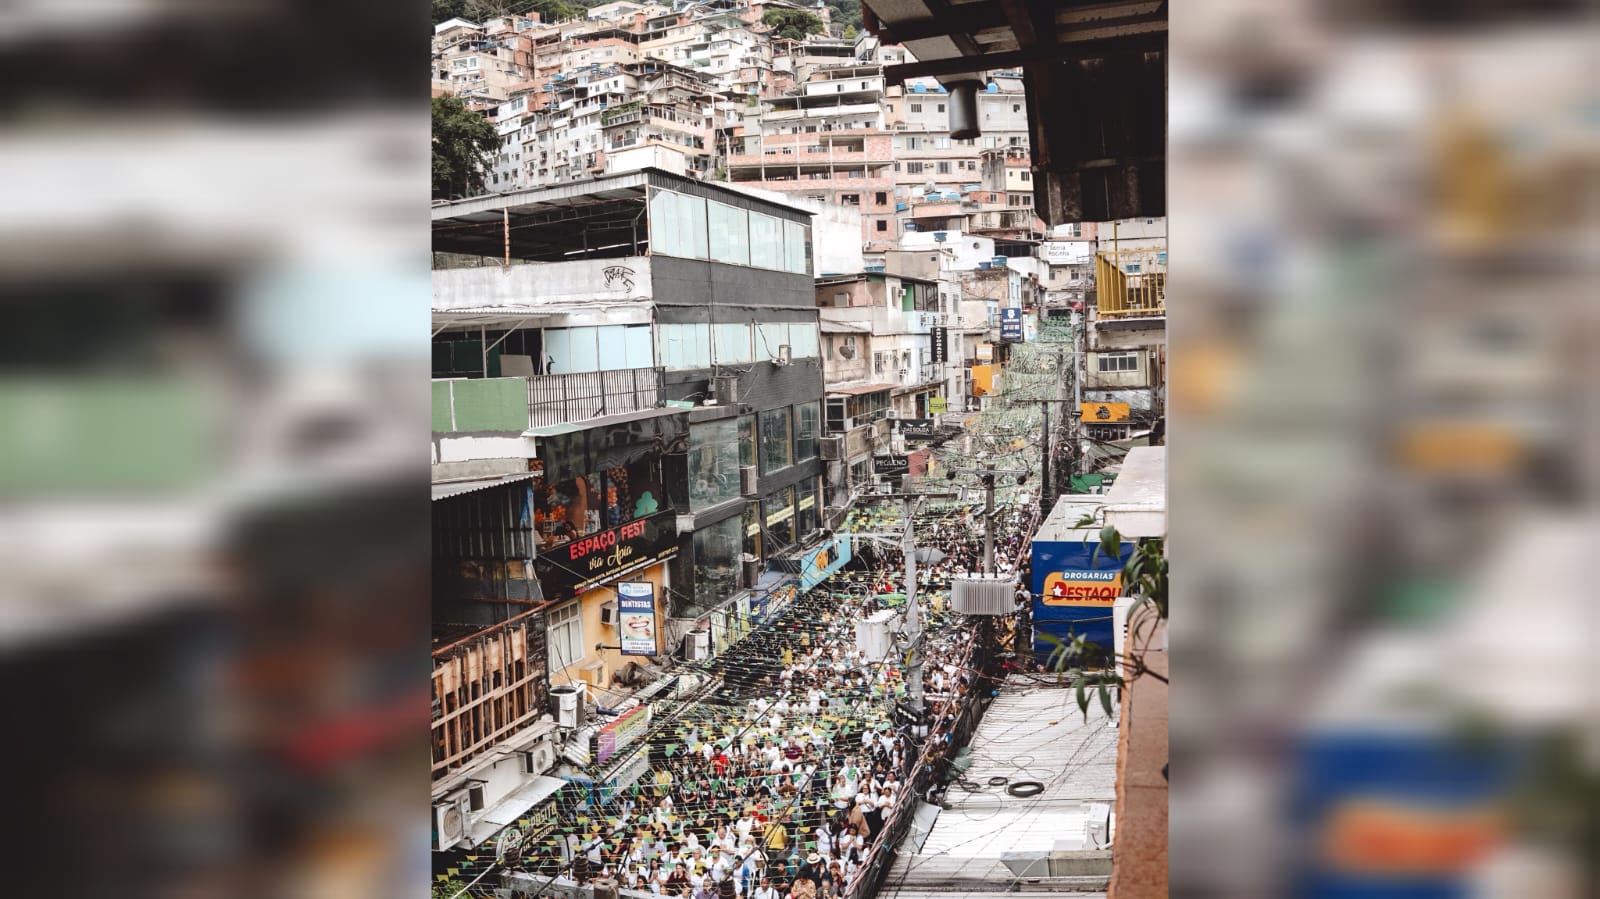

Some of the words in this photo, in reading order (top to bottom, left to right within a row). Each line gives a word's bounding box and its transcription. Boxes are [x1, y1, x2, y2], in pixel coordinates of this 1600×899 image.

[569, 530, 617, 561] ESPAÇO
[621, 519, 647, 541] FEST
[589, 556, 604, 570] via
[607, 544, 633, 566] Apia
[1064, 572, 1114, 580] DROGARIAS
[1052, 581, 1122, 602] DESTAQU
[621, 600, 652, 609] DENTISTAS
